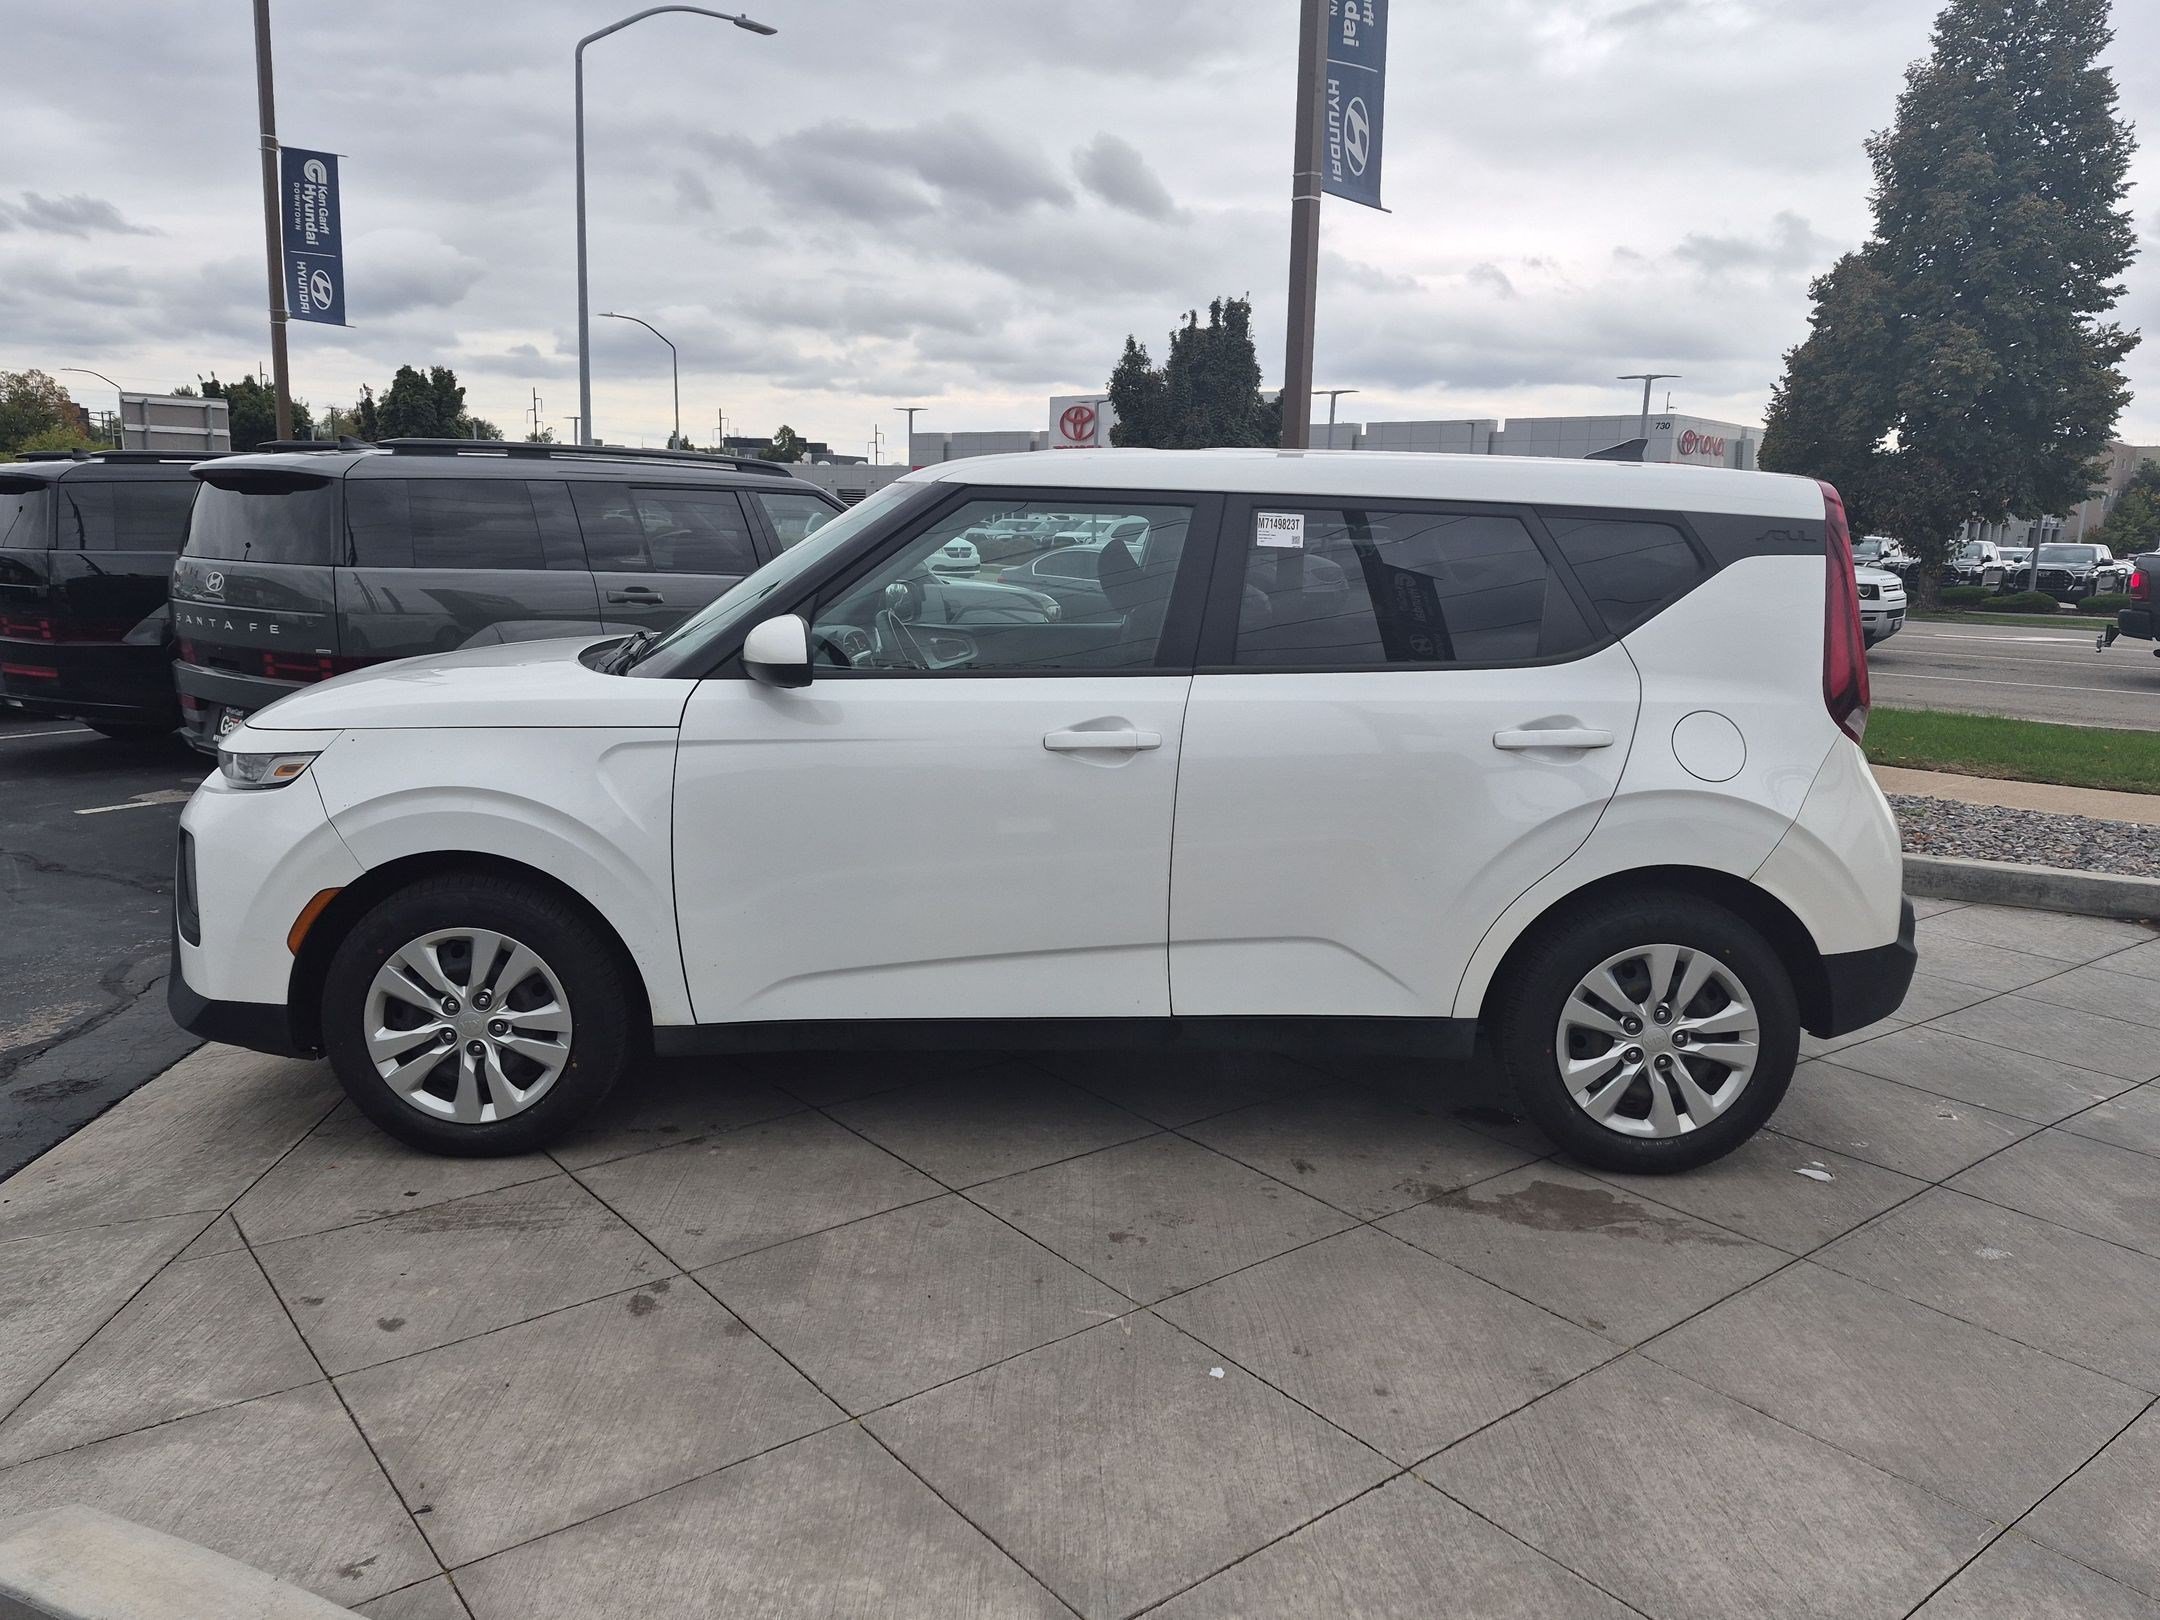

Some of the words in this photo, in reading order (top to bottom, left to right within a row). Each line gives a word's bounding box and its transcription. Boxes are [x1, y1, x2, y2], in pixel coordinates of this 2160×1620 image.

[1328, 79, 1343, 183] HYUNDAI
[293, 182, 302, 231] DOWNTOWN
[317, 186, 328, 207] Ken
[302, 184, 319, 245] Hyundai
[318, 208, 330, 235] Garff
[297, 261, 311, 314] HYUNDAI
[1655, 422, 1671, 430] 730
[1258, 517, 1300, 531] M7149823T
[176, 612, 234, 630] SANTA
[249, 622, 280, 634] FE
